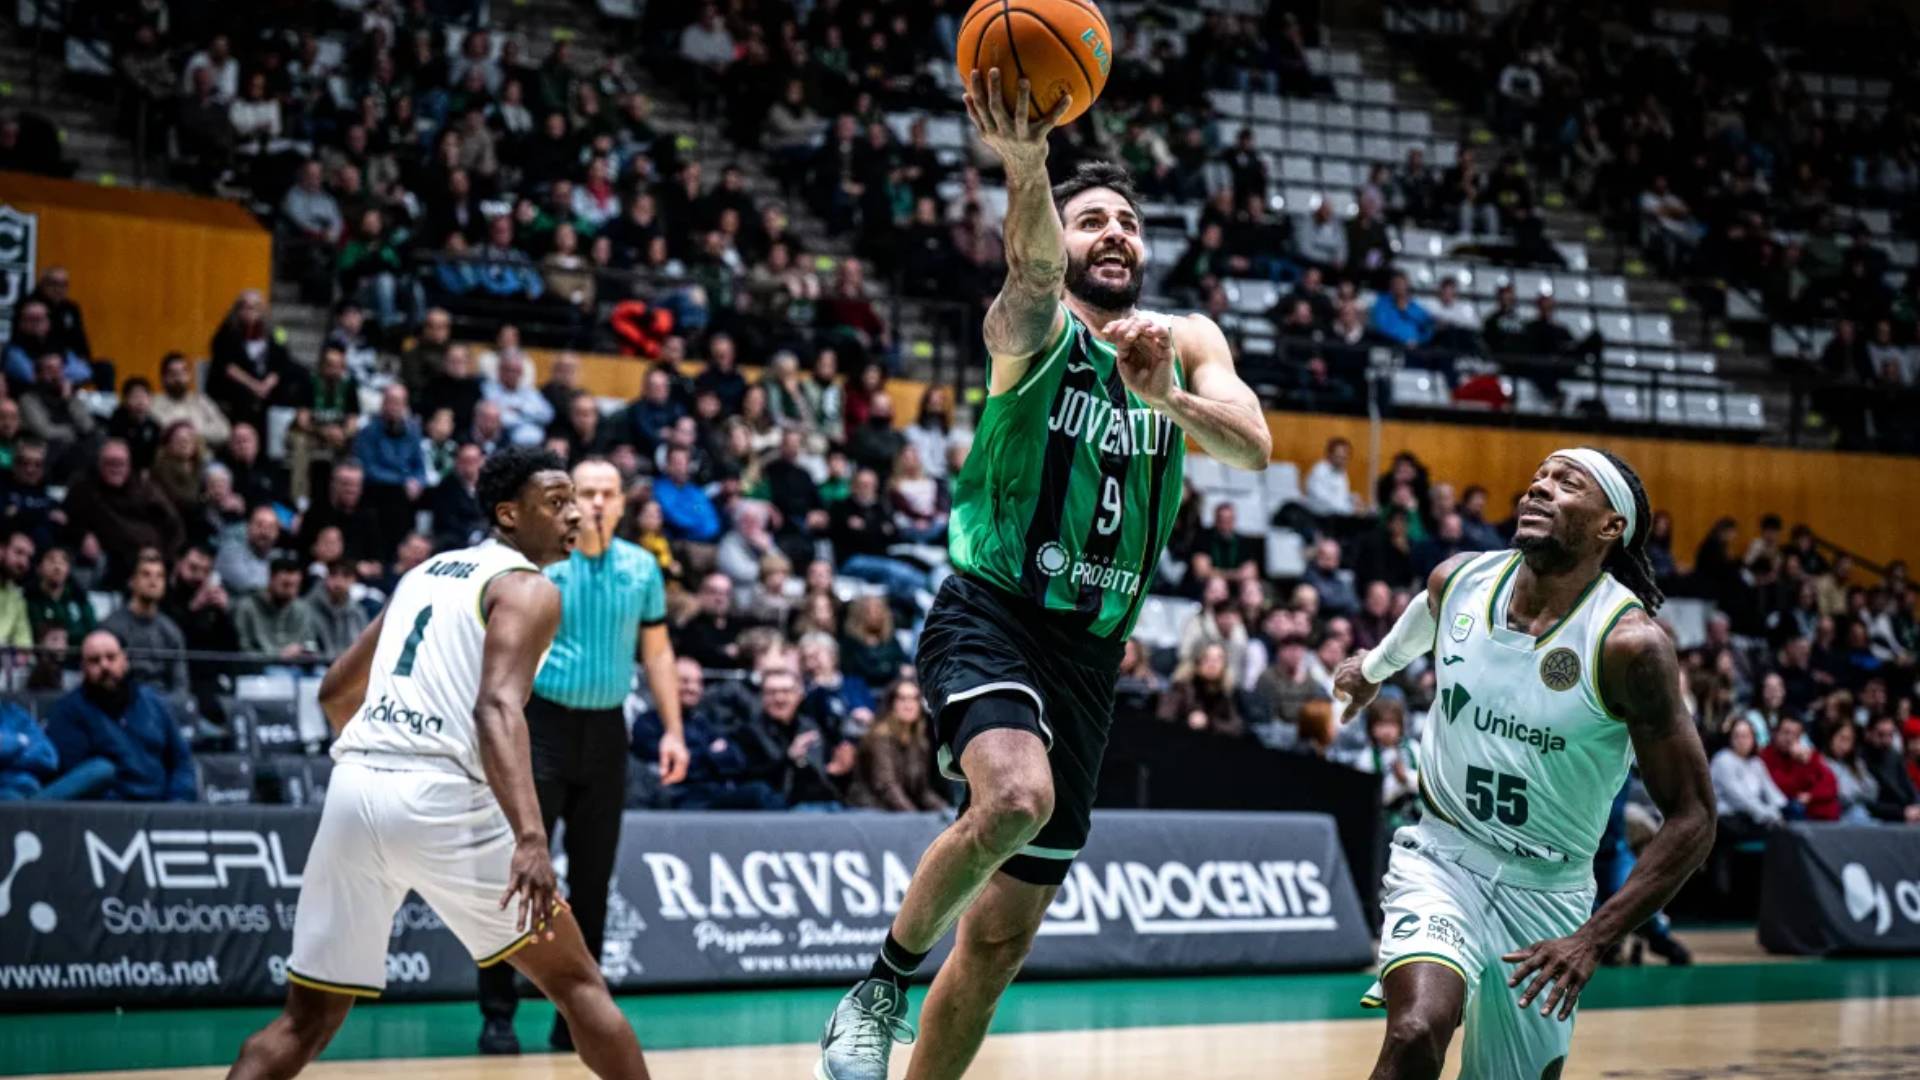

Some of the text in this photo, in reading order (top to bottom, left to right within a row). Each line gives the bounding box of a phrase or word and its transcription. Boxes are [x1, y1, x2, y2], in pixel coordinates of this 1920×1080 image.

[1097, 476, 1121, 535] 9
[1070, 561, 1141, 596] PROBITA
[391, 604, 433, 676] 1
[1473, 706, 1566, 755] Unicaja
[1465, 765, 1529, 827] 55
[85, 829, 304, 889] MERL
[101, 897, 270, 934] Soluciones
[1044, 860, 1332, 921] OMDOCENTS
[0, 956, 220, 988] www.merlos.net
